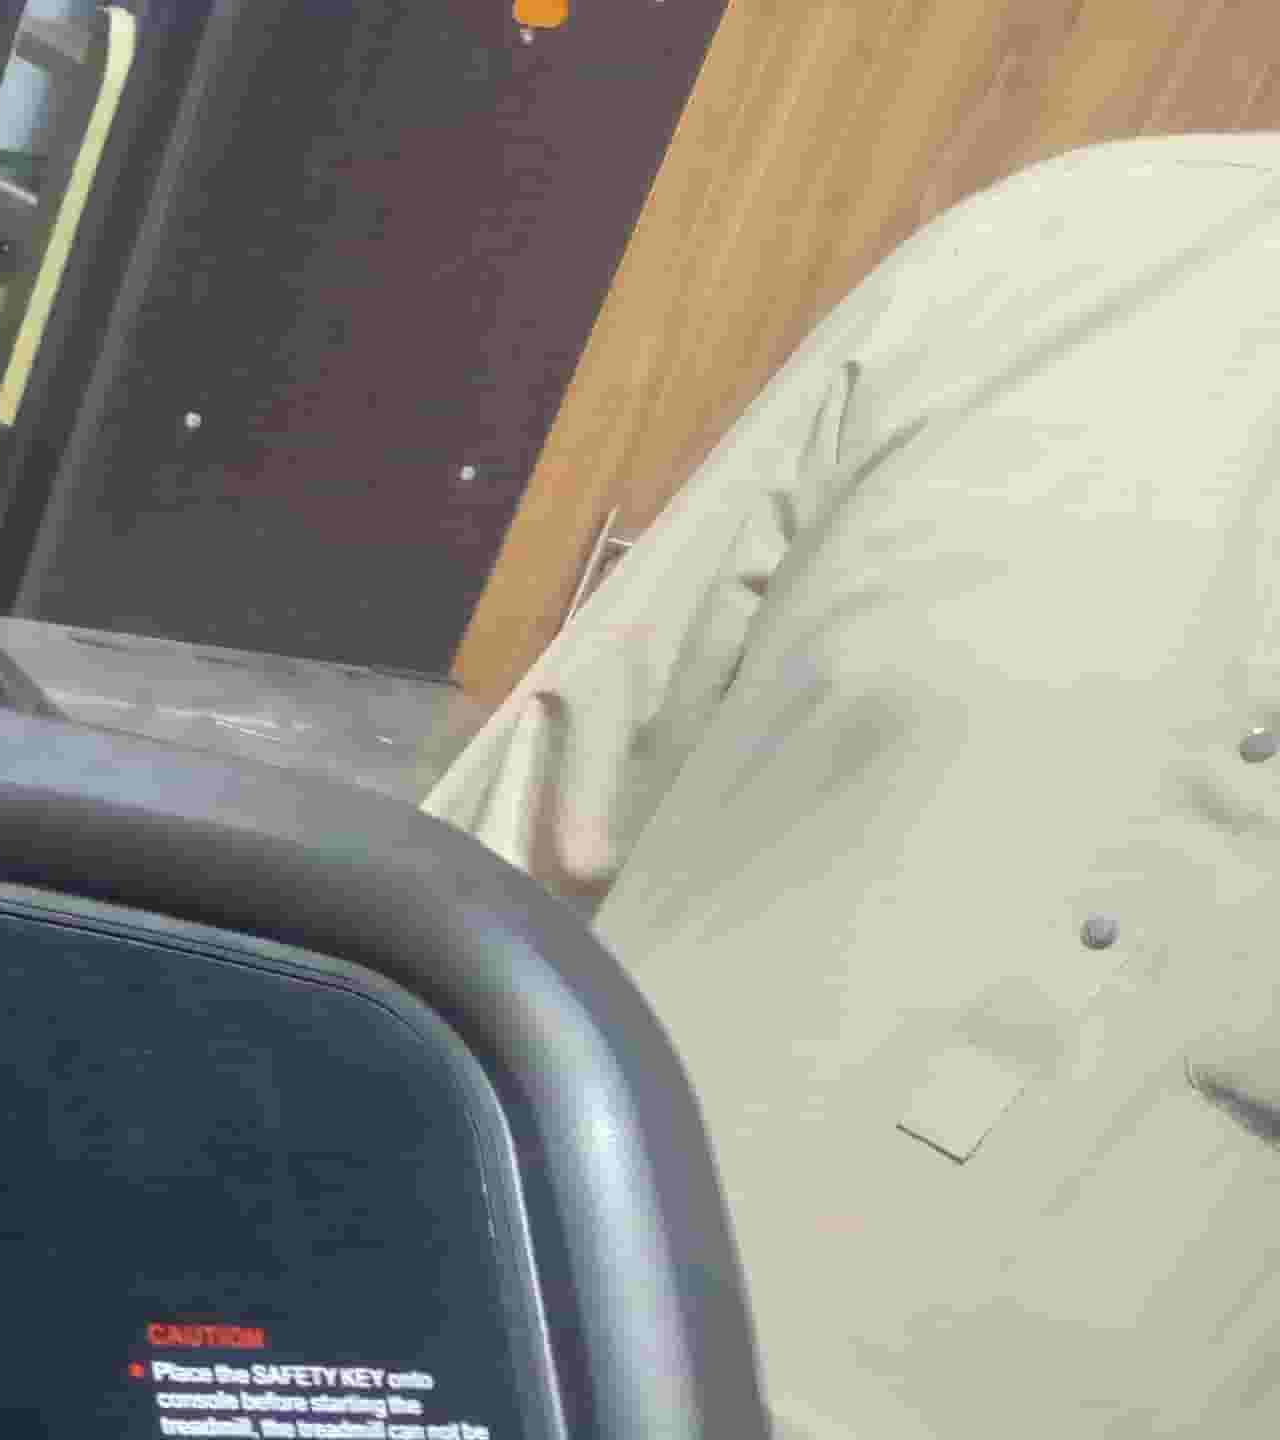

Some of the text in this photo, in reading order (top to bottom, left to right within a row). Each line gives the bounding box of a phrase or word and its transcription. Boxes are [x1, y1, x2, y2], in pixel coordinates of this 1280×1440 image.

[148, 1323, 265, 1348] CAUTION
[152, 1361, 213, 1383] Place
[214, 1363, 249, 1384] the
[251, 1365, 337, 1387] SAFETY
[340, 1367, 385, 1388] KEY
[241, 1392, 308, 1411] before
[310, 1394, 387, 1418] starting
[388, 1396, 423, 1415] the
[387, 1425, 425, 1439] can
[428, 1423, 459, 1440] not
[460, 1422, 490, 1440] be
